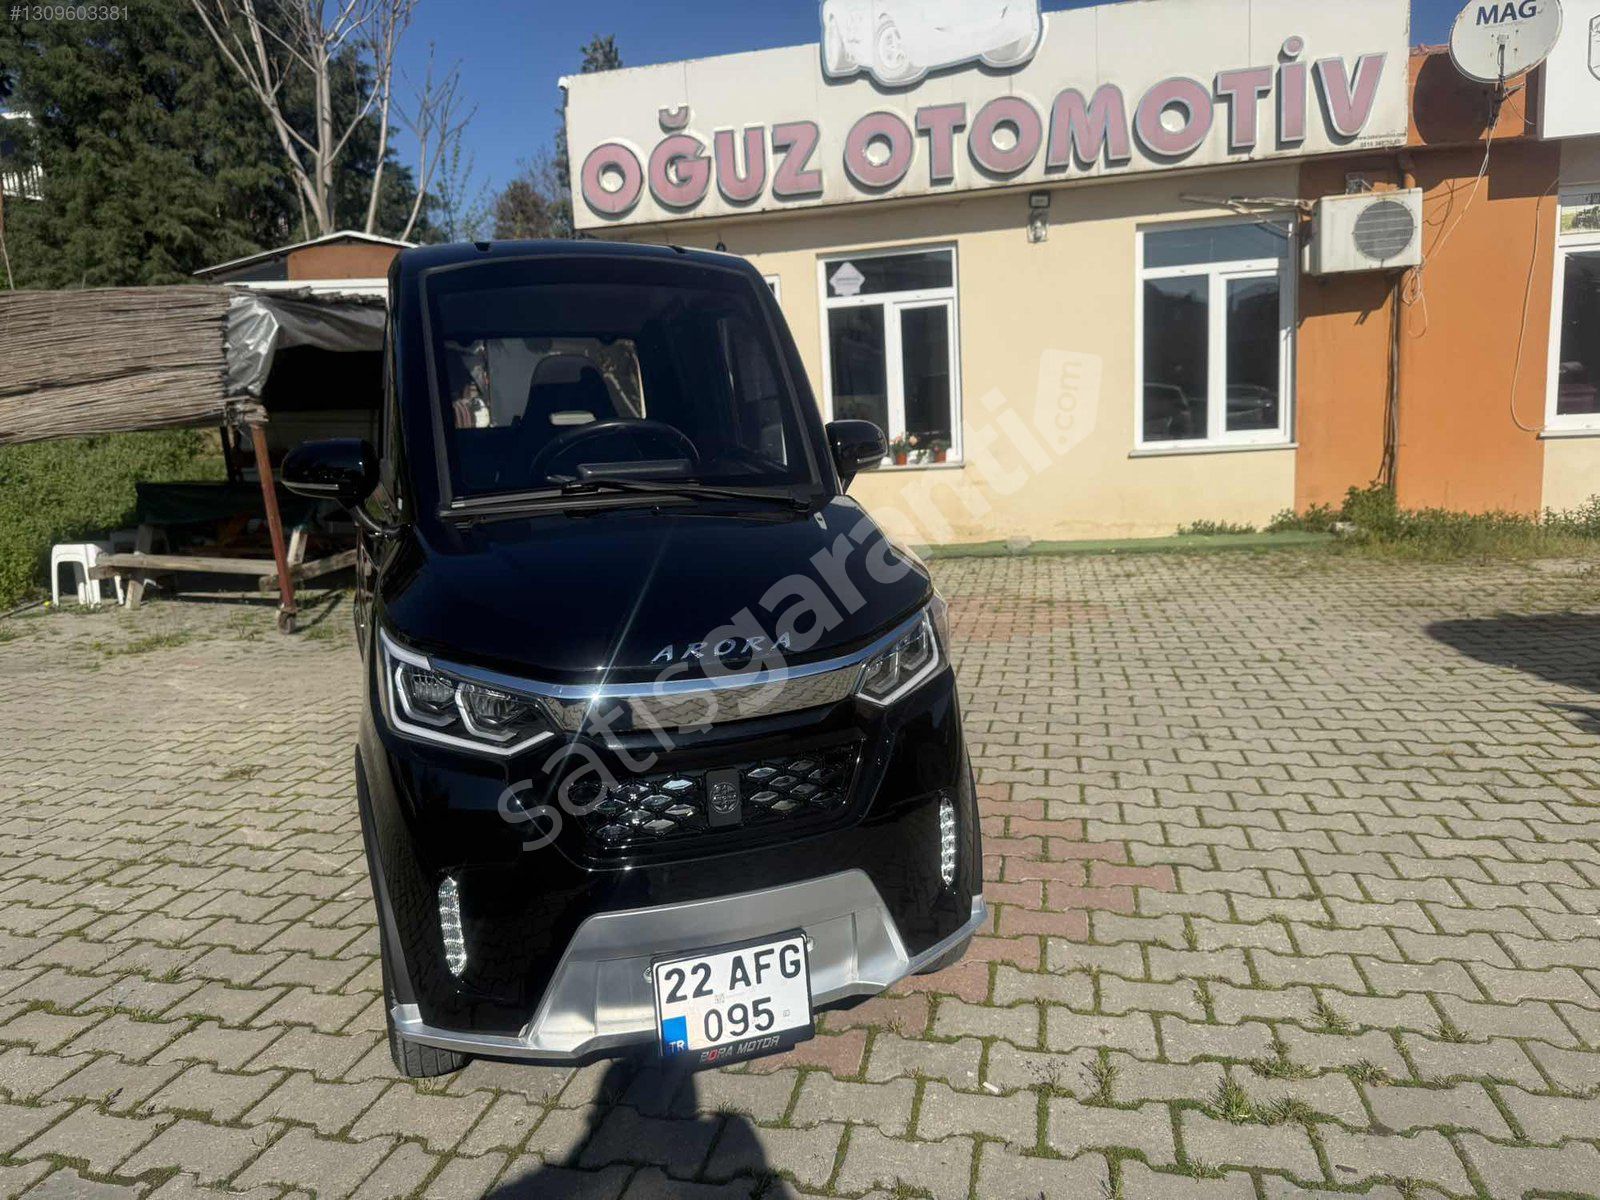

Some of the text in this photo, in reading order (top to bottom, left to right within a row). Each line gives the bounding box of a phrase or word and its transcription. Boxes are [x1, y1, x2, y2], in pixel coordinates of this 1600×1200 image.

[1476, 0, 1537, 25] MAG
[580, 35, 1388, 218] OĞUZ OTOMOTİV
[650, 631, 791, 664] ARORA
[664, 944, 801, 1004] 22 AFG
[704, 996, 775, 1042] 095
[668, 1039, 686, 1054] TR
[736, 1034, 780, 1055] MOTOR
